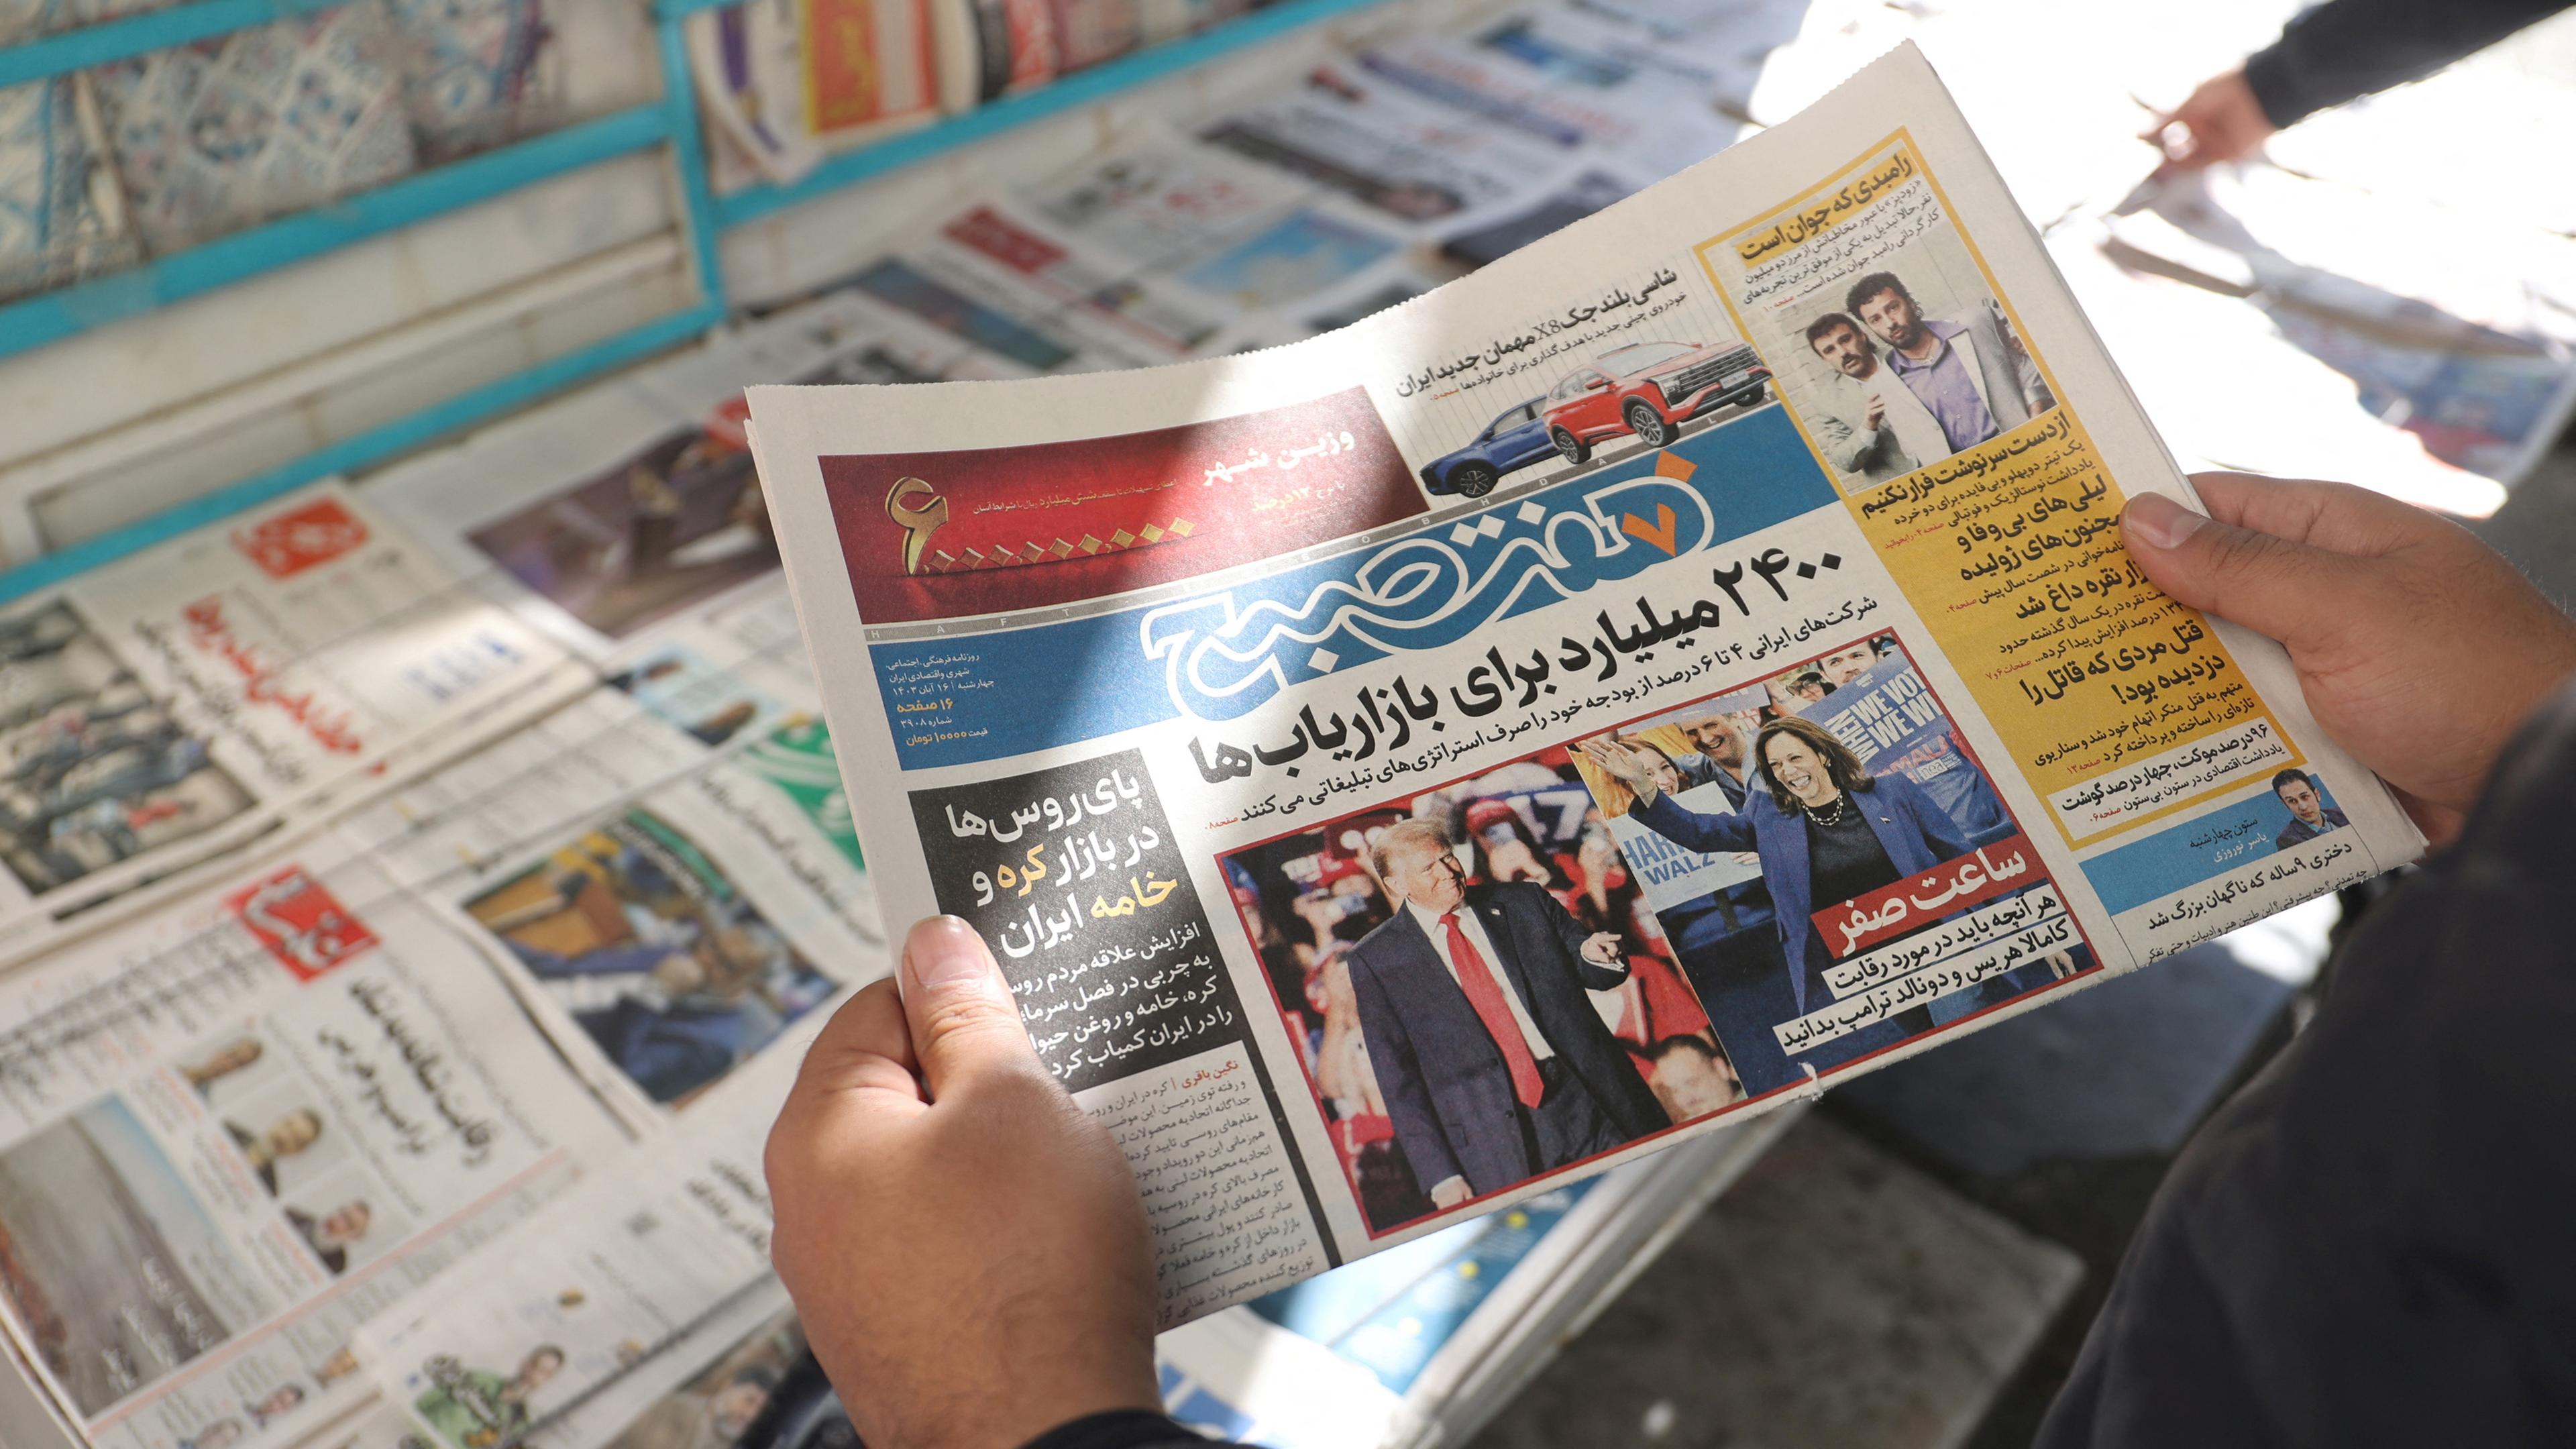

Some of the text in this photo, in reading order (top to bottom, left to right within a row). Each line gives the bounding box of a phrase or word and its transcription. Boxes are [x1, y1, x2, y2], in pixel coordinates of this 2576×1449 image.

[1741, 153, 1913, 260] رامبدی که جوان است
[1397, 268, 1677, 398] شاسی بلند جک X8 مهمان جدید ایران
[1202, 423, 1356, 487] وزین شهر
[1861, 411, 2071, 520] از دست سرنوشت فرار نکنیم
[1957, 535, 1972, 554] و
[1966, 513, 2027, 542] بی‌وفا
[1713, 548, 1841, 616] ۲۴۰۰
[2016, 568, 2123, 619] نقره داغ شد
[1558, 596, 1720, 683] میلیارد
[1729, 643, 1743, 660] ۴
[1749, 627, 1791, 661] ایرانی
[1701, 655, 1713, 672] ۶
[1714, 649, 1731, 665] تا
[2019, 619, 2204, 706] قتل مردی که قاتل را
[2157, 655, 2226, 689] دزدیده
[1450, 645, 1558, 718] برای
[1638, 675, 1654, 696] از
[1656, 664, 1701, 688] درصد
[896, 698, 953, 713] ۱۶ صفحه
[1550, 700, 1582, 723] خود
[1586, 687, 1640, 708] بودجه
[1849, 666, 1927, 726] WE VOT
[900, 716, 953, 729] شماره ۳۹۰۸
[1486, 720, 1532, 743] صرف
[1530, 712, 1548, 731] را
[1823, 708, 1880, 765] WHEN
[1867, 690, 1944, 749] WE WI
[2034, 682, 2243, 767] متهم به قتل منکر اتهام خود شد و سناریوی
[2250, 723, 2267, 739] ۹۶
[906, 727, 989, 747] قیمت ۱۰۰۰۰ تومان
[2218, 733, 2254, 753] درصد
[1077, 768, 1143, 815] پای
[1309, 767, 1373, 806] تبلیغاتی
[2106, 774, 2143, 795] درصد
[2143, 763, 2172, 787] چهار
[2061, 782, 2104, 811] گوشت
[2190, 818, 2259, 849] ستون چهارشنبه
[2213, 832, 2270, 863] یاسر نوروزی
[972, 816, 1160, 908] در بازار کره و
[1644, 853, 1715, 885] WALZ
[1839, 847, 2027, 957] ساعت صفر
[2149, 843, 2352, 930] دختری ۹ ساله که ناگهان بزرگ شد
[1000, 871, 1178, 959] خامه ایران
[1835, 896, 2057, 989] هر آنچه باید در مورد رقابت
[1784, 917, 2069, 1047] کامالا هریس و دونالد ترامپ بدانید
